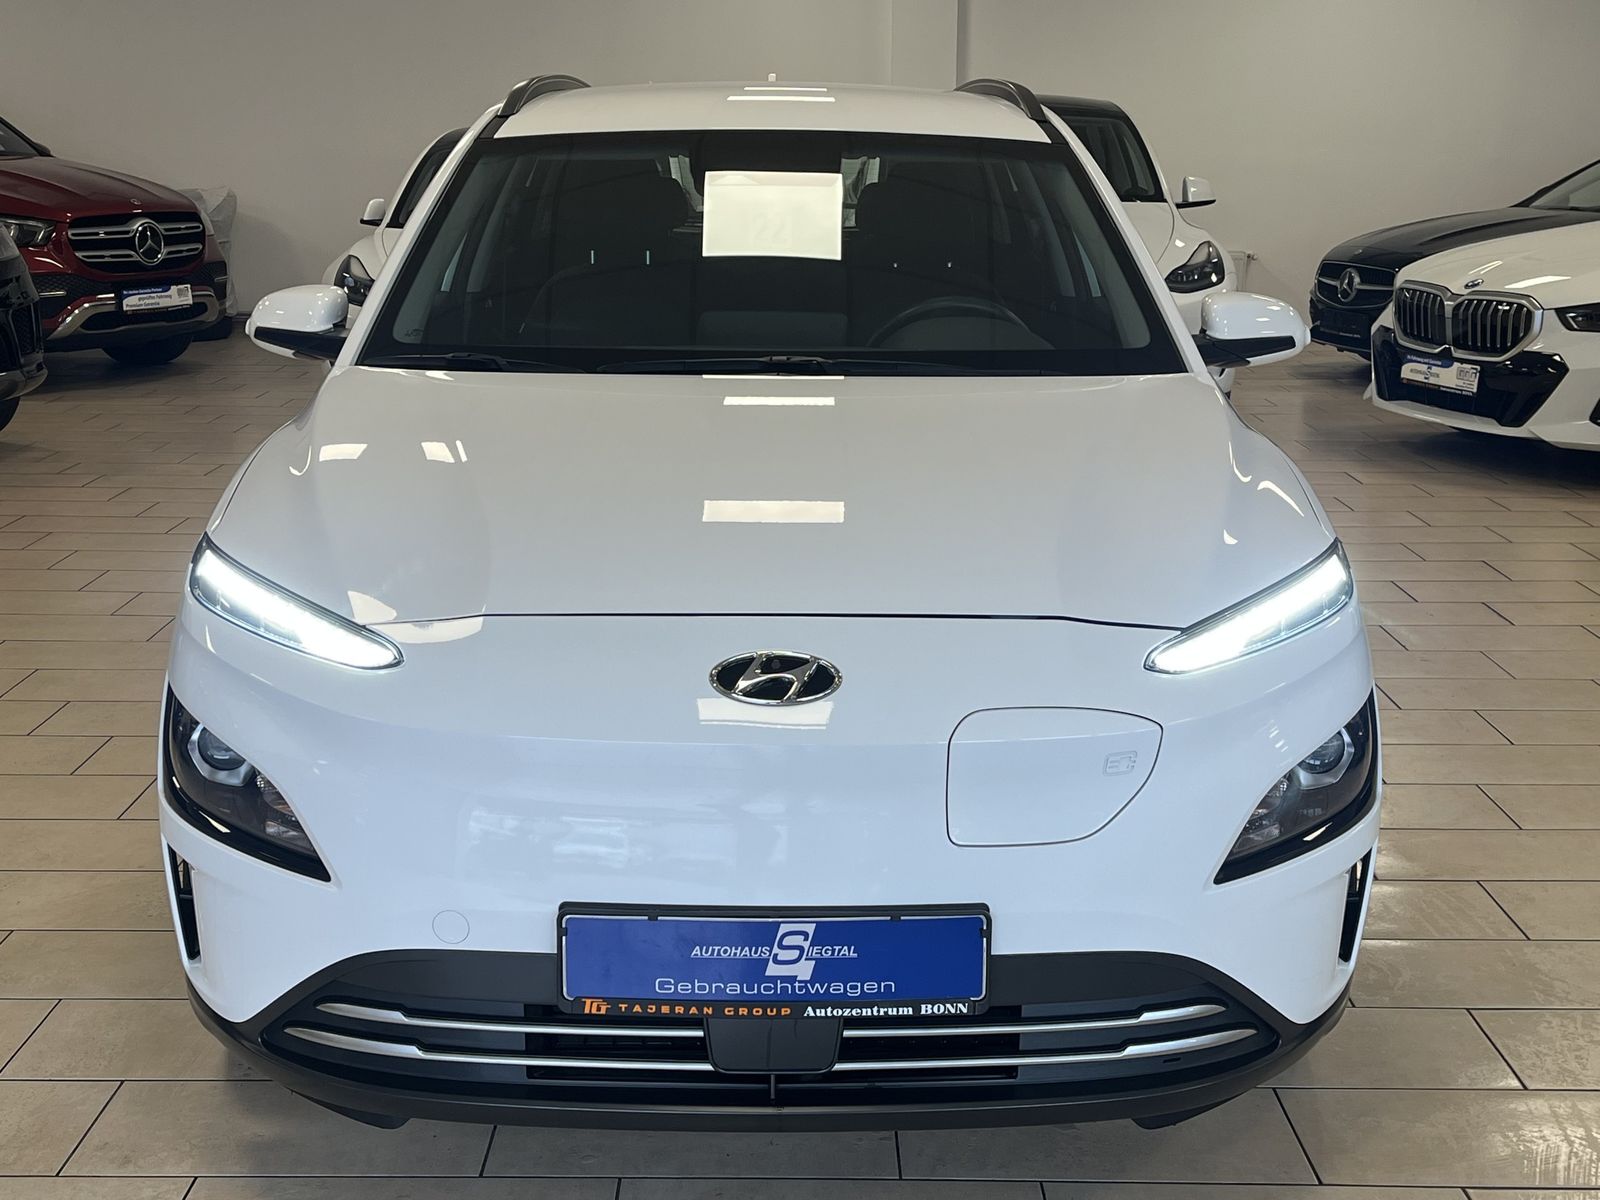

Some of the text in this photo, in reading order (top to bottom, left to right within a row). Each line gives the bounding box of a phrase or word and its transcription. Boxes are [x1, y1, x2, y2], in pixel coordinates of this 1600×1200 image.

[691, 946, 770, 957] AUTOHAUS
[655, 977, 896, 996] Gebrauchtwagen
[618, 1003, 713, 1015] TAJERAN
[724, 1006, 791, 1016] GROUP
[803, 1005, 913, 1017] Autozentrum
[920, 1002, 969, 1015] BONN
